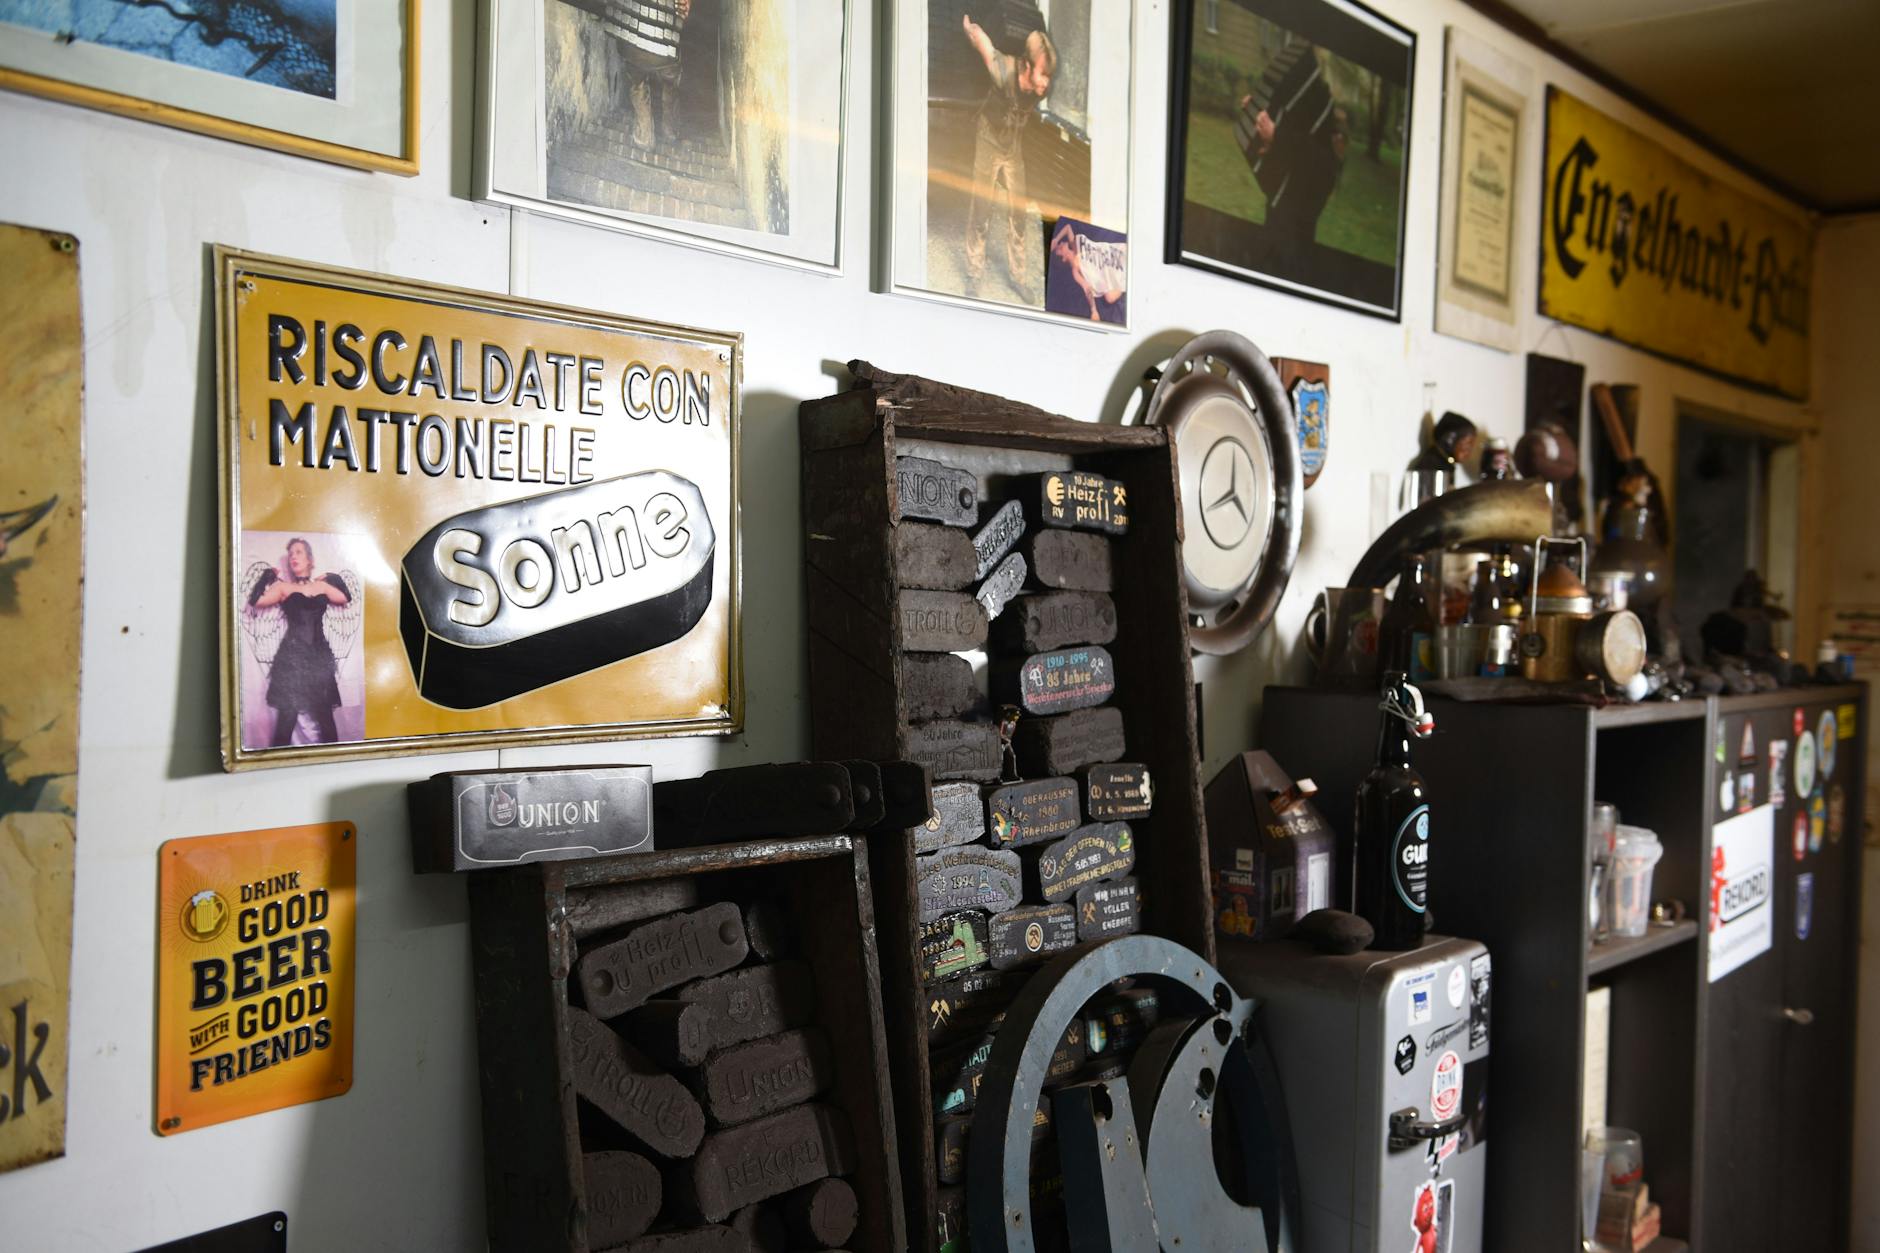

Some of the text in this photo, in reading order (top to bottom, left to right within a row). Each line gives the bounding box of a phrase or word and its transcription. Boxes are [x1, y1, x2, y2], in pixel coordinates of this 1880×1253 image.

[267, 313, 711, 427] RISCALDATE CON
[268, 398, 596, 485] MATTONELLE
[433, 492, 691, 629] Sonne
[519, 799, 600, 829] UNION
[1022, 819, 1076, 839] Rheinbraun
[239, 871, 301, 903] DRINK
[951, 873, 976, 890] 1994
[1723, 871, 1767, 909] REKORD
[237, 888, 330, 944] GOOD
[190, 927, 332, 1012] BEER
[189, 980, 329, 1049] WITH GOOD
[189, 1018, 332, 1092] FRIENDS
